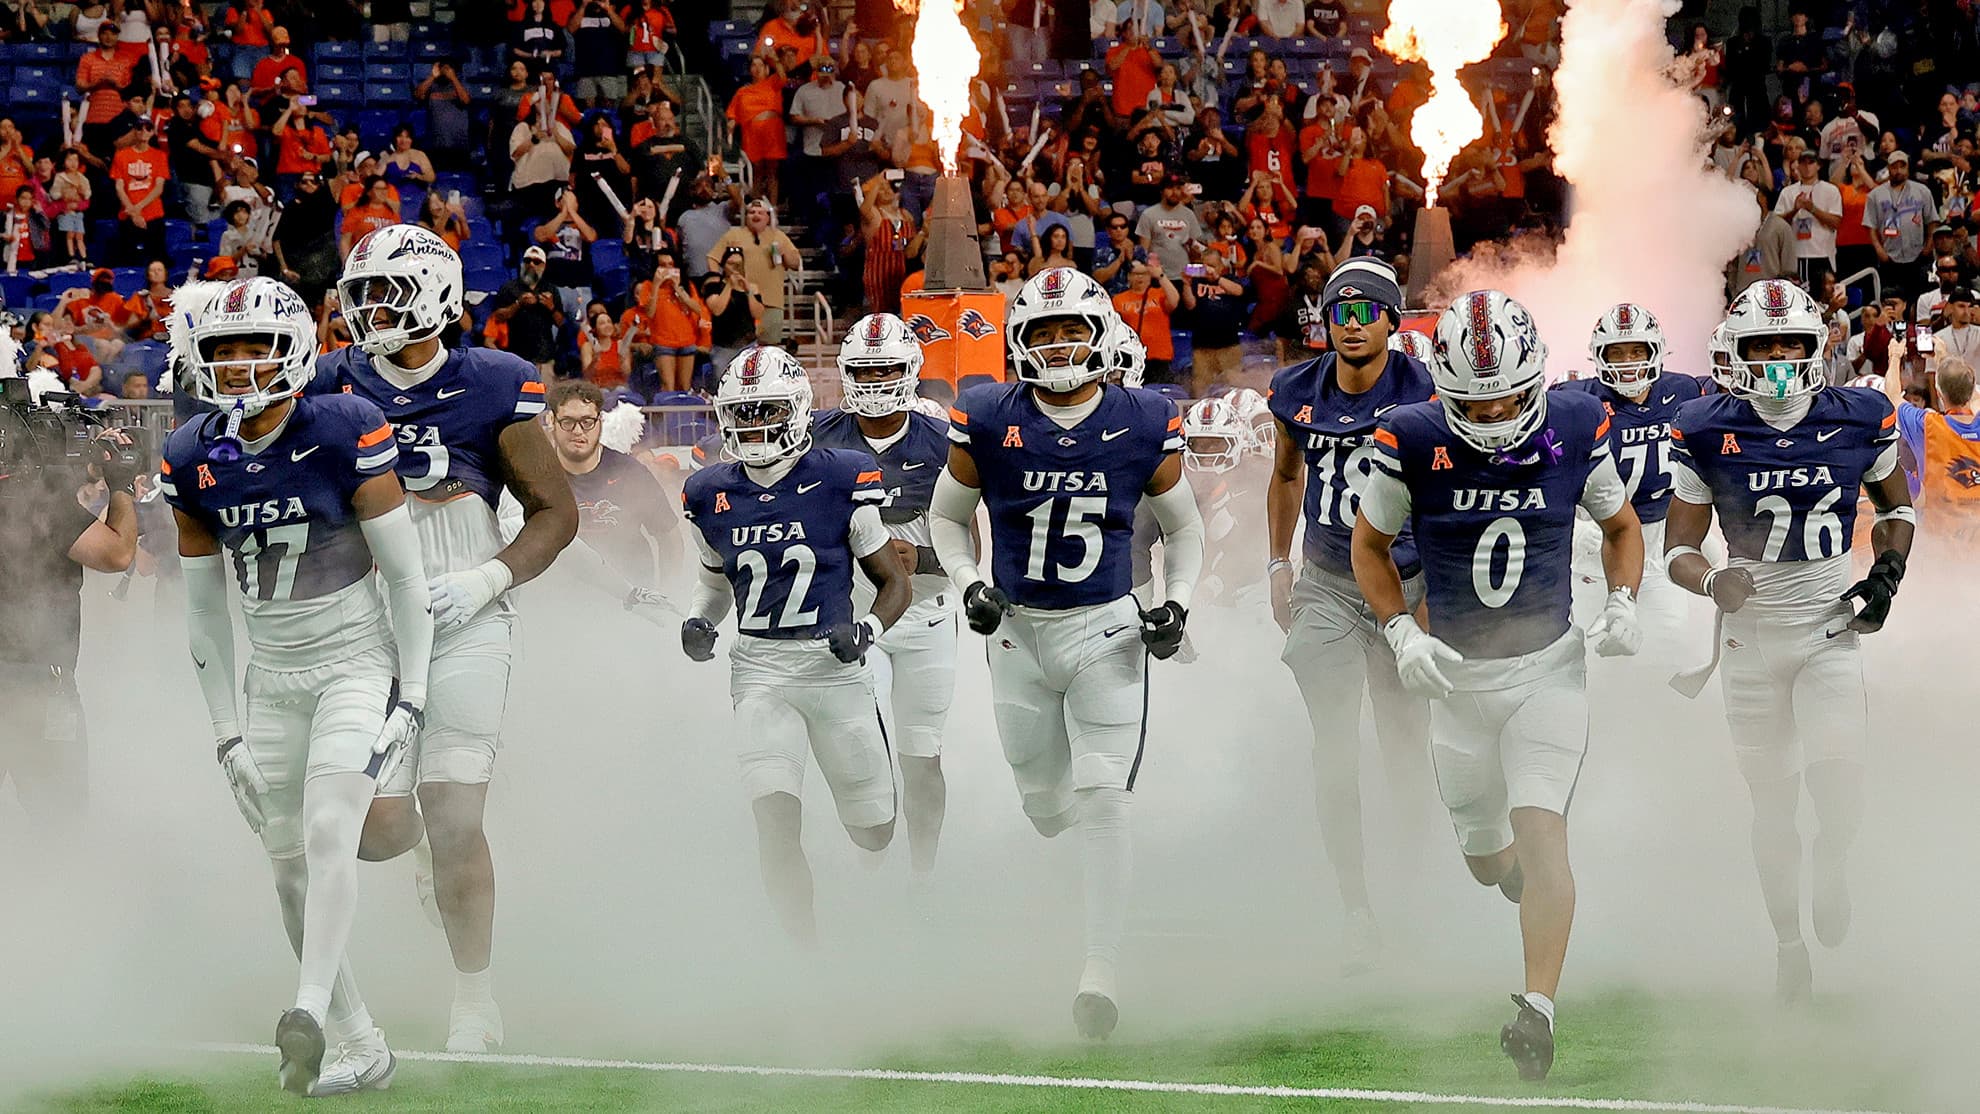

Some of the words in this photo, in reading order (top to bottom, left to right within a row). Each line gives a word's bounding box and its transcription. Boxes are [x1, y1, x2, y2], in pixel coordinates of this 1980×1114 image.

[1267, 150, 1280, 171] 6
[350, 262, 366, 271] 210
[1043, 300, 1063, 309] 210
[1768, 318, 1789, 326] 210
[740, 386, 758, 394] 210
[1478, 381, 1499, 390] 210
[1621, 422, 1672, 443] UTSA
[1023, 471, 1108, 492] UTSA
[1619, 439, 1677, 500] 75
[1749, 466, 1834, 491] UTSA
[1317, 446, 1377, 528] 18
[1453, 488, 1547, 511] UTSA
[218, 497, 309, 528] UTSA
[1754, 487, 1843, 562] 26
[731, 521, 806, 546] UTSA
[1024, 496, 1108, 583] 15
[239, 523, 309, 600] 17
[1472, 517, 1527, 609] 0
[737, 544, 819, 630] 22
